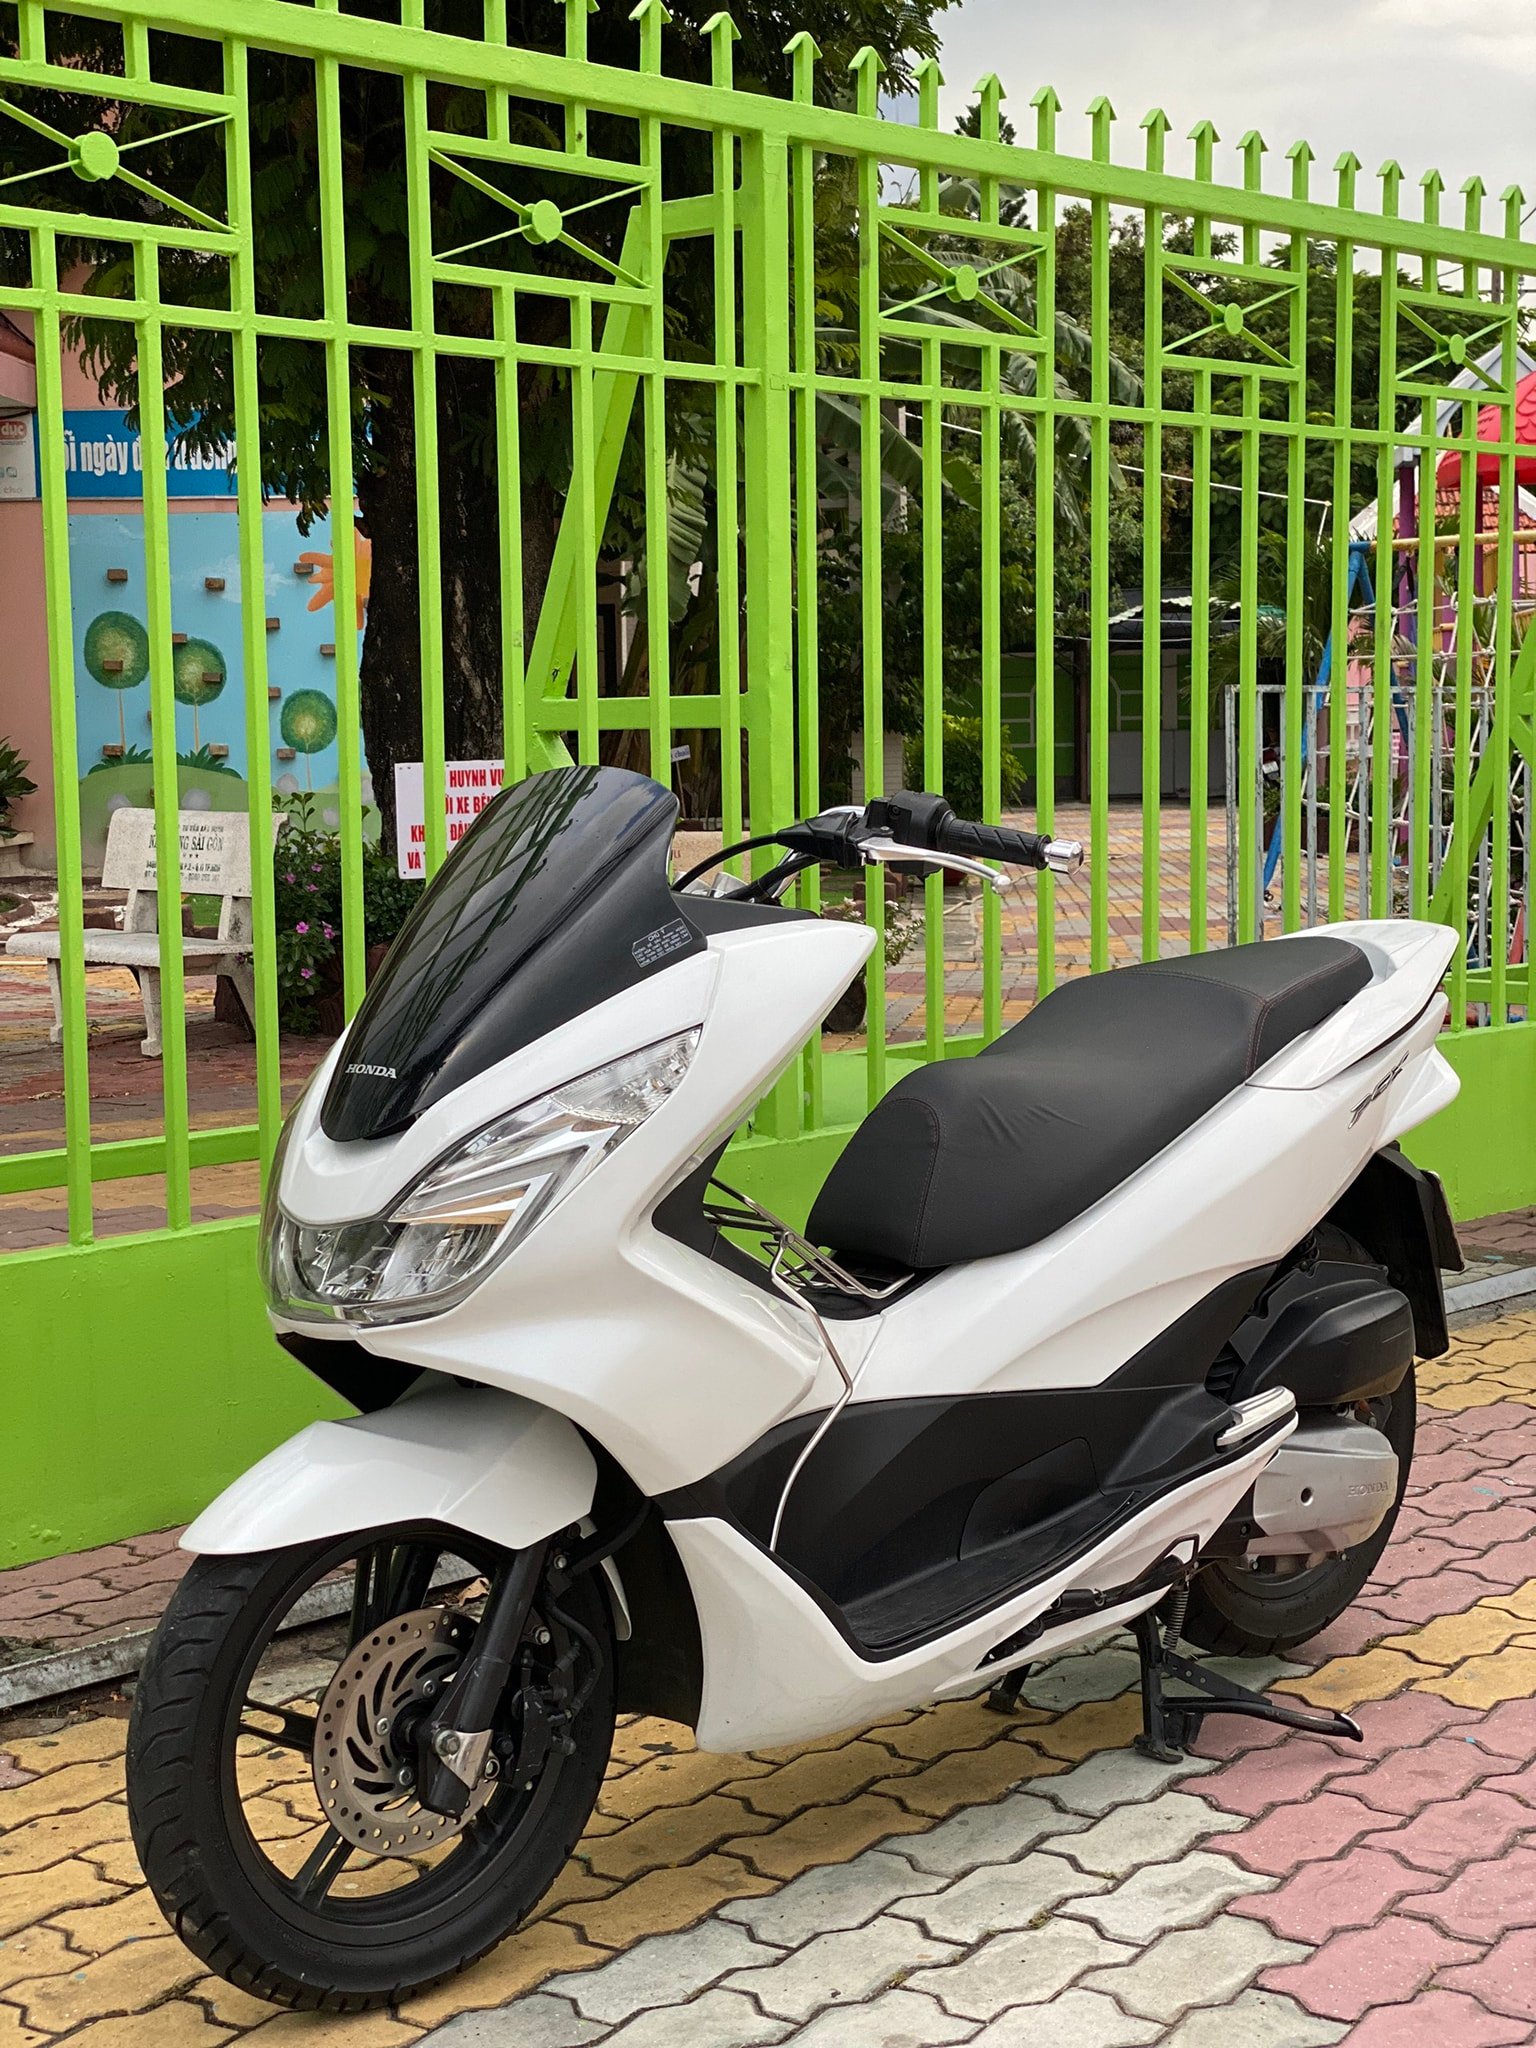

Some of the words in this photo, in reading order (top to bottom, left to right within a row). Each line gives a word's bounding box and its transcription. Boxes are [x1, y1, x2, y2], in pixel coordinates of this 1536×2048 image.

[80, 433, 128, 477] ngày
[450, 769, 487, 788] HUYNH
[490, 768, 505, 787] VU
[457, 796, 470, 815] XE
[407, 848, 422, 870] VÀ
[345, 1063, 397, 1080] HONDA
[1347, 1481, 1389, 1498] HONDA
